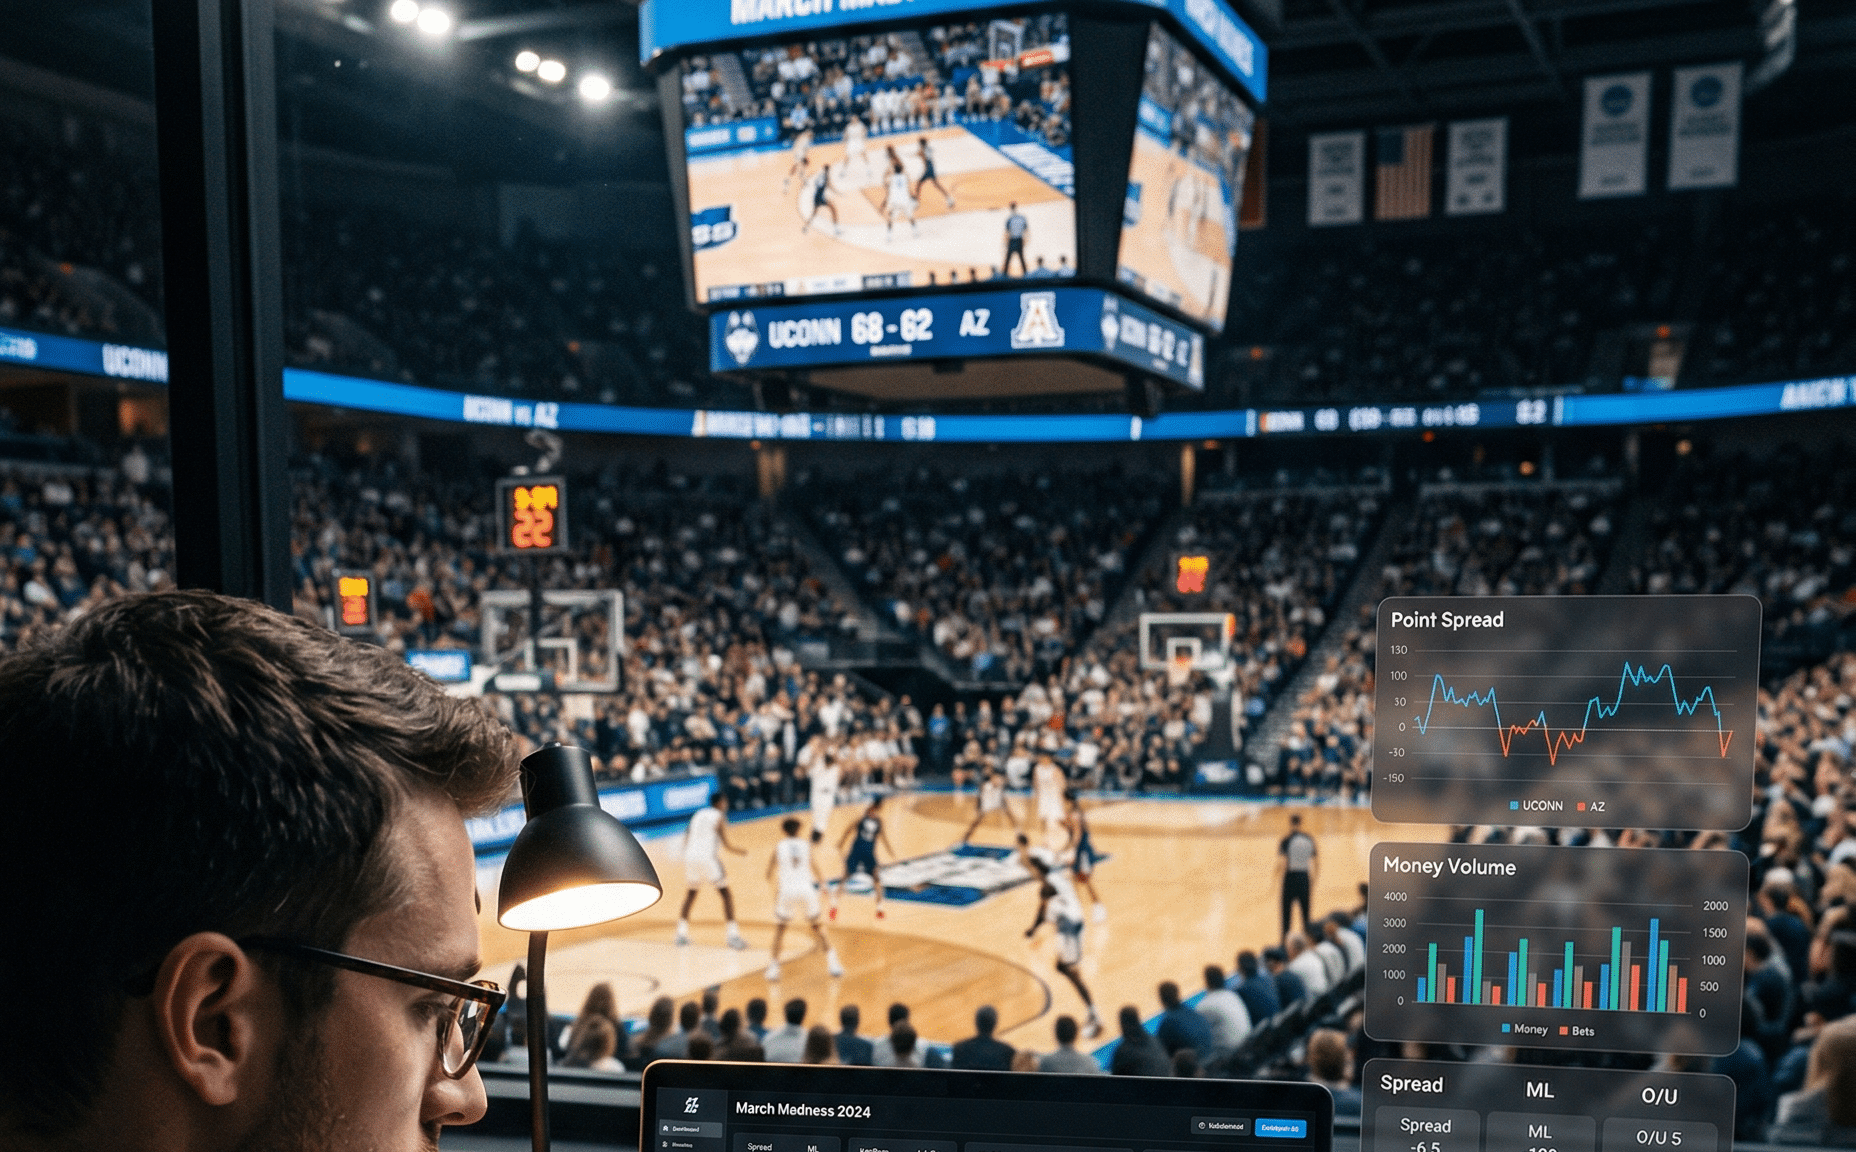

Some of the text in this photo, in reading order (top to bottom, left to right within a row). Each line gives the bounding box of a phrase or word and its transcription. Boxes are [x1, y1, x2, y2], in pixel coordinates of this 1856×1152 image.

[769, 318, 841, 349] UCONN
[960, 309, 990, 337] AZ
[1391, 611, 1504, 631] Point Spread
[1391, 645, 1408, 655] 130
[1391, 671, 1408, 681] 100
[1398, 722, 1406, 731] 0
[1523, 800, 1563, 812] UCONN
[1590, 802, 1606, 812] AZ
[1384, 857, 1517, 878] Money Volume
[1384, 891, 1408, 902] 4000
[1703, 900, 1729, 911] 2000
[1383, 918, 1407, 929] 3000
[1703, 928, 1727, 939] 1500
[1382, 944, 1407, 955] 2000
[1702, 955, 1726, 966] 1000
[1383, 969, 1406, 980] 1000
[1700, 982, 1719, 992] 500
[1397, 996, 1404, 1006] 0
[1699, 1008, 1706, 1018] 0
[1514, 1023, 1549, 1037] Money
[1572, 1025, 1595, 1037] Bets
[1380, 1074, 1444, 1094] Spread
[1526, 1082, 1555, 1099] ML
[1642, 1087, 1678, 1105] O/U
[736, 1102, 775, 1115] March
[838, 1105, 871, 1119] 2024
[1400, 1117, 1452, 1135] Spread
[1528, 1125, 1552, 1139] ML
[1636, 1129, 1682, 1146] O/U 5
